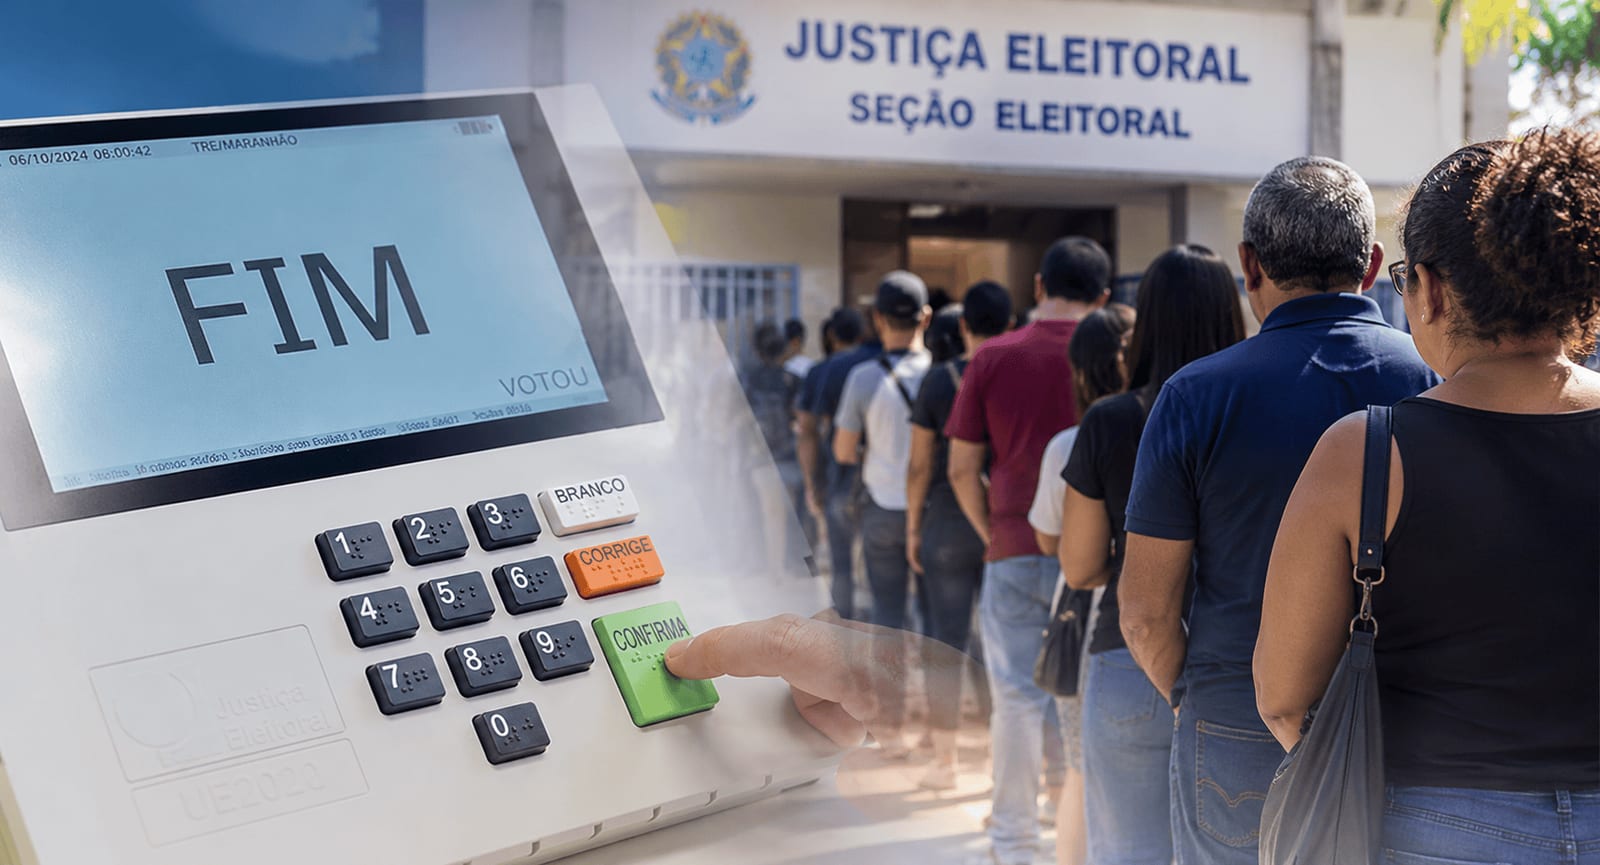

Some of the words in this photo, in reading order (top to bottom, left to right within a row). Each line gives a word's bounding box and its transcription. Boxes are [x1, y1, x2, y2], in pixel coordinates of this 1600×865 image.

[784, 19, 987, 79] JUSTIÇA
[1005, 32, 1251, 85] ELEITORAL
[848, 90, 974, 134] SEÇÃO
[995, 100, 1191, 139] ELEITORAL
[8, 149, 89, 166] 06/10/2024
[93, 145, 152, 160] 08:00:42
[191, 133, 298, 154] TRE/MARANHÃO
[165, 244, 430, 365] FIM
[498, 366, 590, 398] VOTOU
[554, 477, 626, 504] BRANCO
[484, 502, 503, 525] 3
[410, 517, 432, 541] 2
[335, 532, 351, 555] 1
[579, 537, 652, 567] CORRIGE
[511, 566, 529, 589] 6
[437, 580, 456, 604] 5
[360, 596, 378, 621] 4
[536, 630, 556, 655] 9
[612, 615, 690, 653] CONFIRMA
[463, 647, 483, 671] 8
[382, 663, 399, 689] 7
[215, 685, 308, 720] Justiça
[224, 709, 333, 752] Eleitoral
[490, 713, 510, 737] 0
